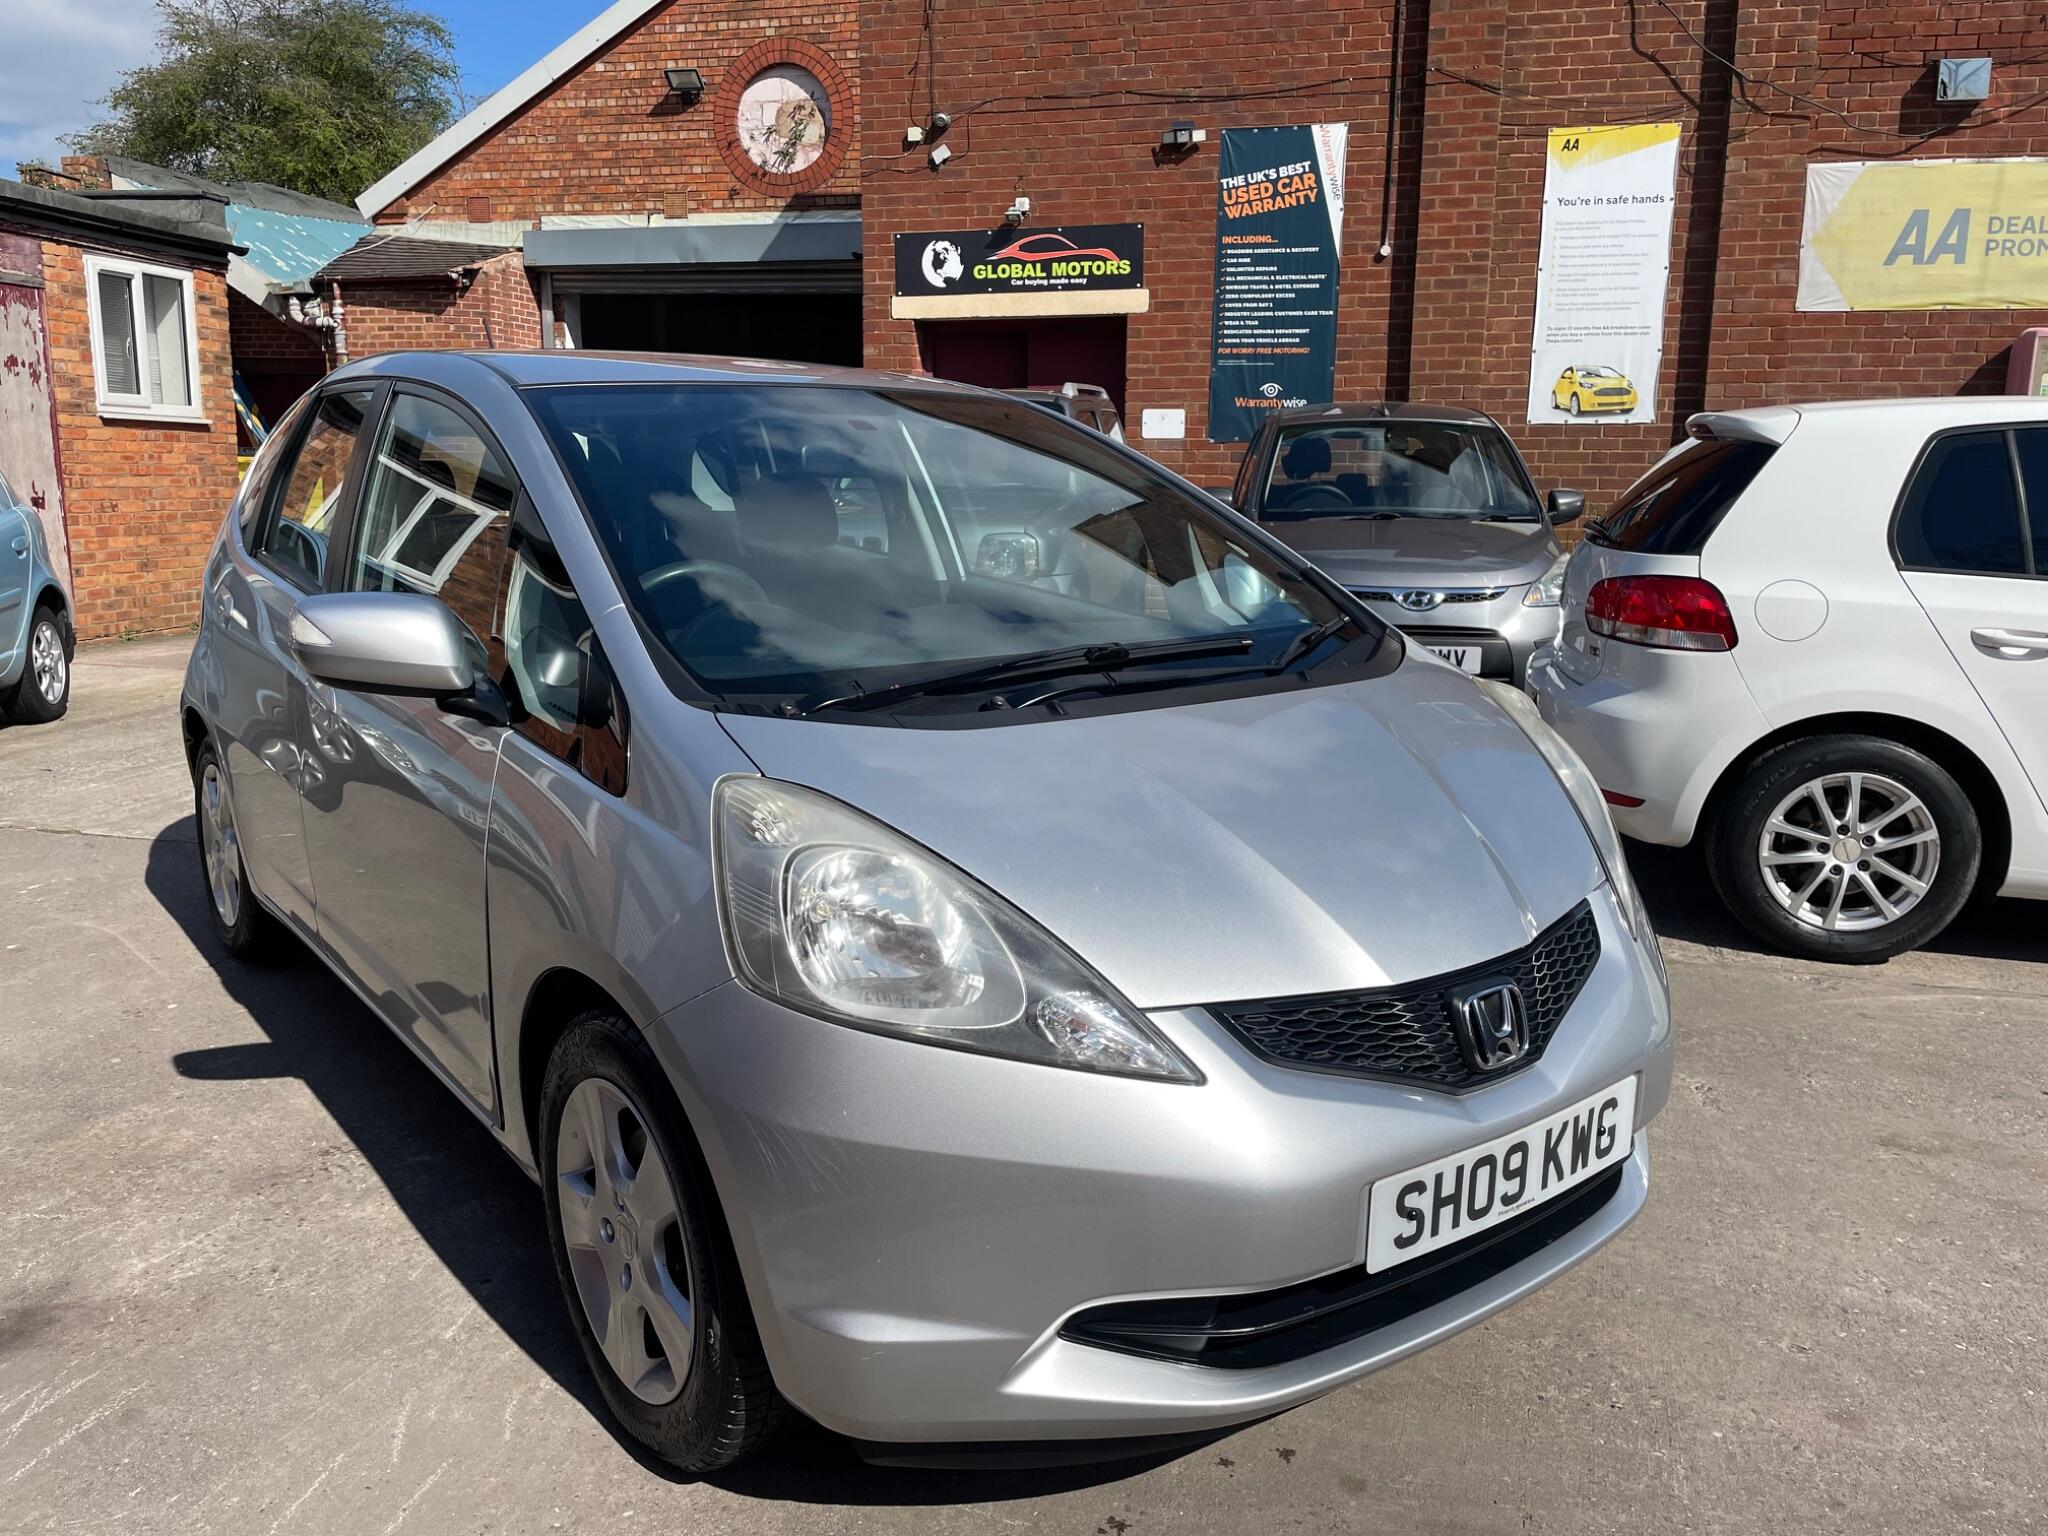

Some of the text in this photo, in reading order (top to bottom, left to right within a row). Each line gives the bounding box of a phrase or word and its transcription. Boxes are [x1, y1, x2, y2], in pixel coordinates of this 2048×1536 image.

[1561, 138, 1580, 152] AA
[1221, 161, 1311, 190] THE UK'S BEST
[1320, 126, 1341, 201] Warrantywise
[1223, 173, 1318, 205] USED CAR
[1557, 194, 1665, 207] You're in safe hands
[1224, 188, 1319, 220] WARRANTY
[1882, 208, 1972, 266] AA
[973, 260, 1131, 279] GLOBAL MOTORS
[1025, 279, 1048, 287] buying
[1235, 397, 1308, 410] Warrantywise
[1430, 649, 1466, 668] WV
[1393, 1096, 1618, 1250] SH09 KWG
